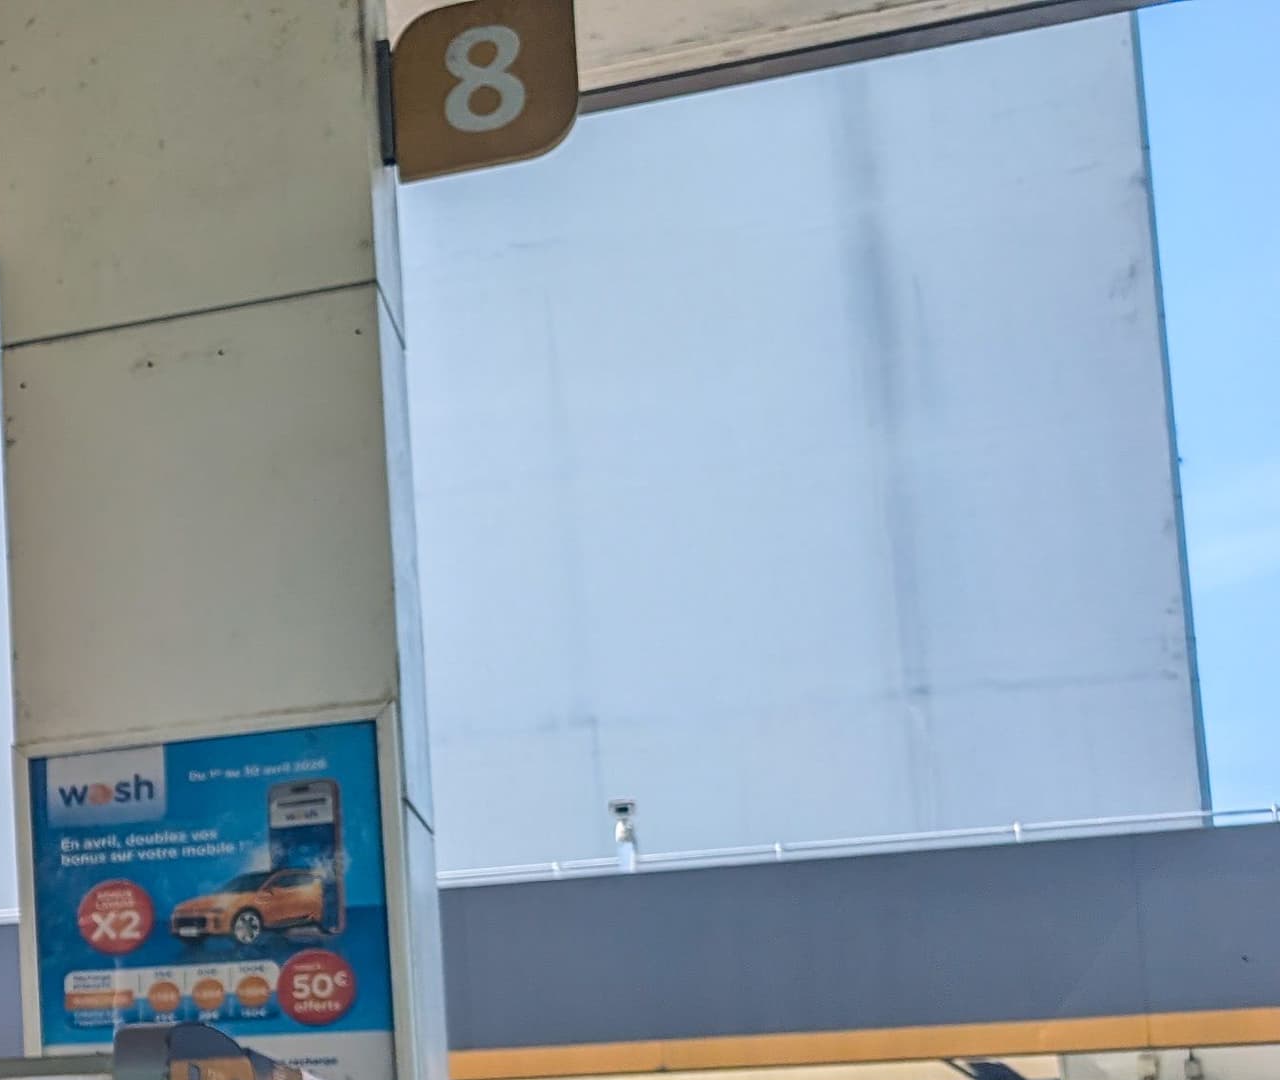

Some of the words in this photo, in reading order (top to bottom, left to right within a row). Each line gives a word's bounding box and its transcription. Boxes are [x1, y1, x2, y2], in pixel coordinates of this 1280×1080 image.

[444, 24, 527, 133] 8
[60, 836, 80, 851] En
[91, 909, 142, 941] X2
[291, 970, 351, 999] 50€
